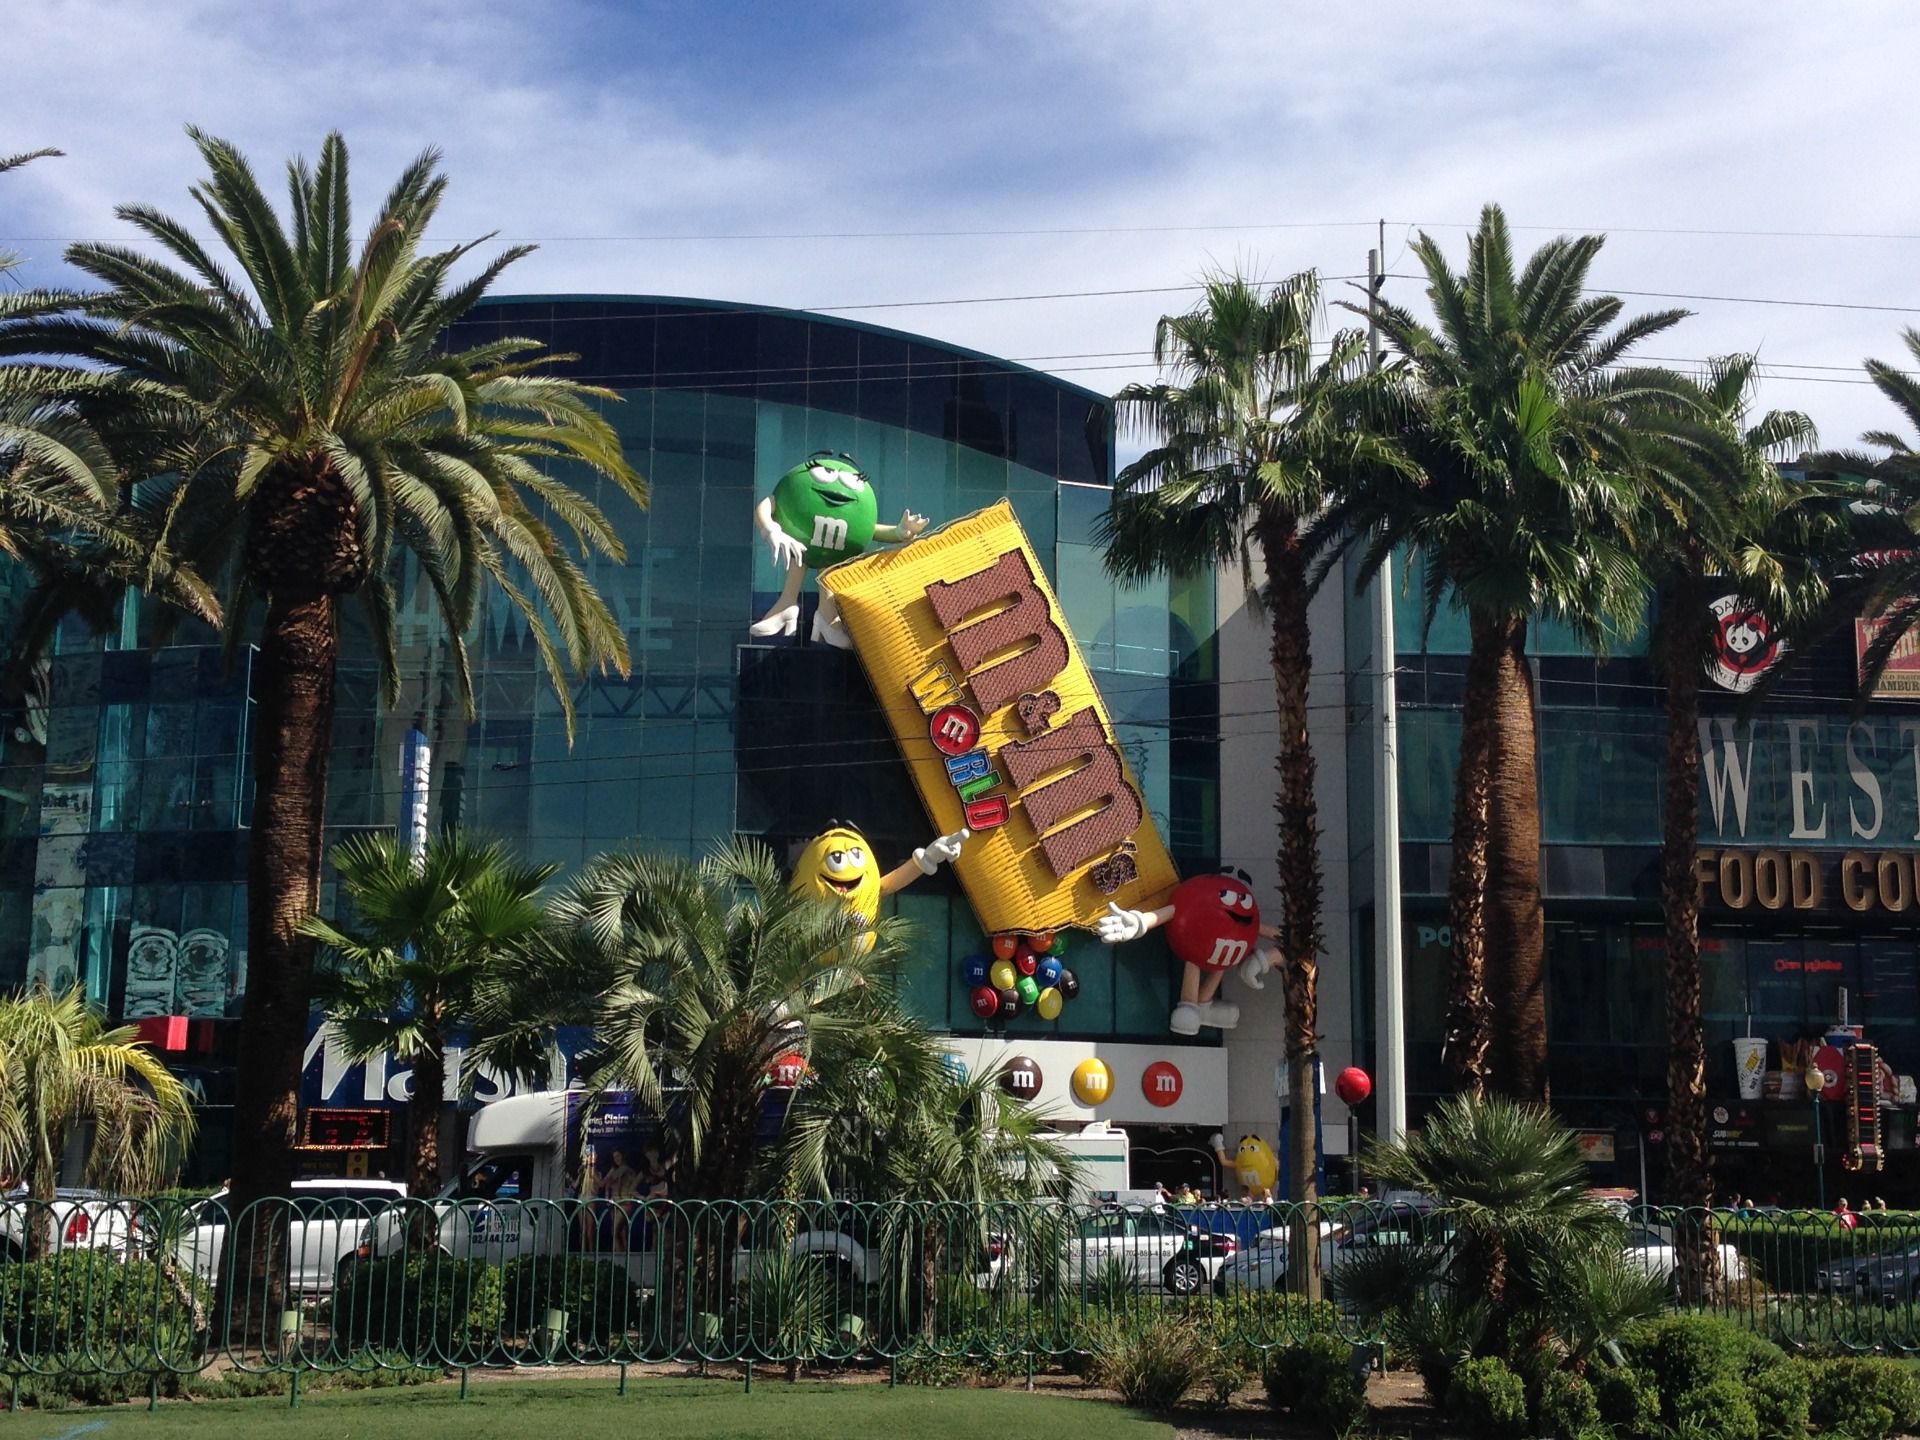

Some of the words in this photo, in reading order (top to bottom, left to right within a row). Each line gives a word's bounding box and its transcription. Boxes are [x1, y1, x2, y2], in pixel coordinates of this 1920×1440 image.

[811, 515, 848, 551] m
[1695, 848, 1823, 910] FOOD
[1842, 850, 1920, 912] CO
[1207, 938, 1248, 967] m
[1012, 1071, 1035, 1088] m
[1086, 1073, 1108, 1089] m
[1156, 1075, 1176, 1092] m
